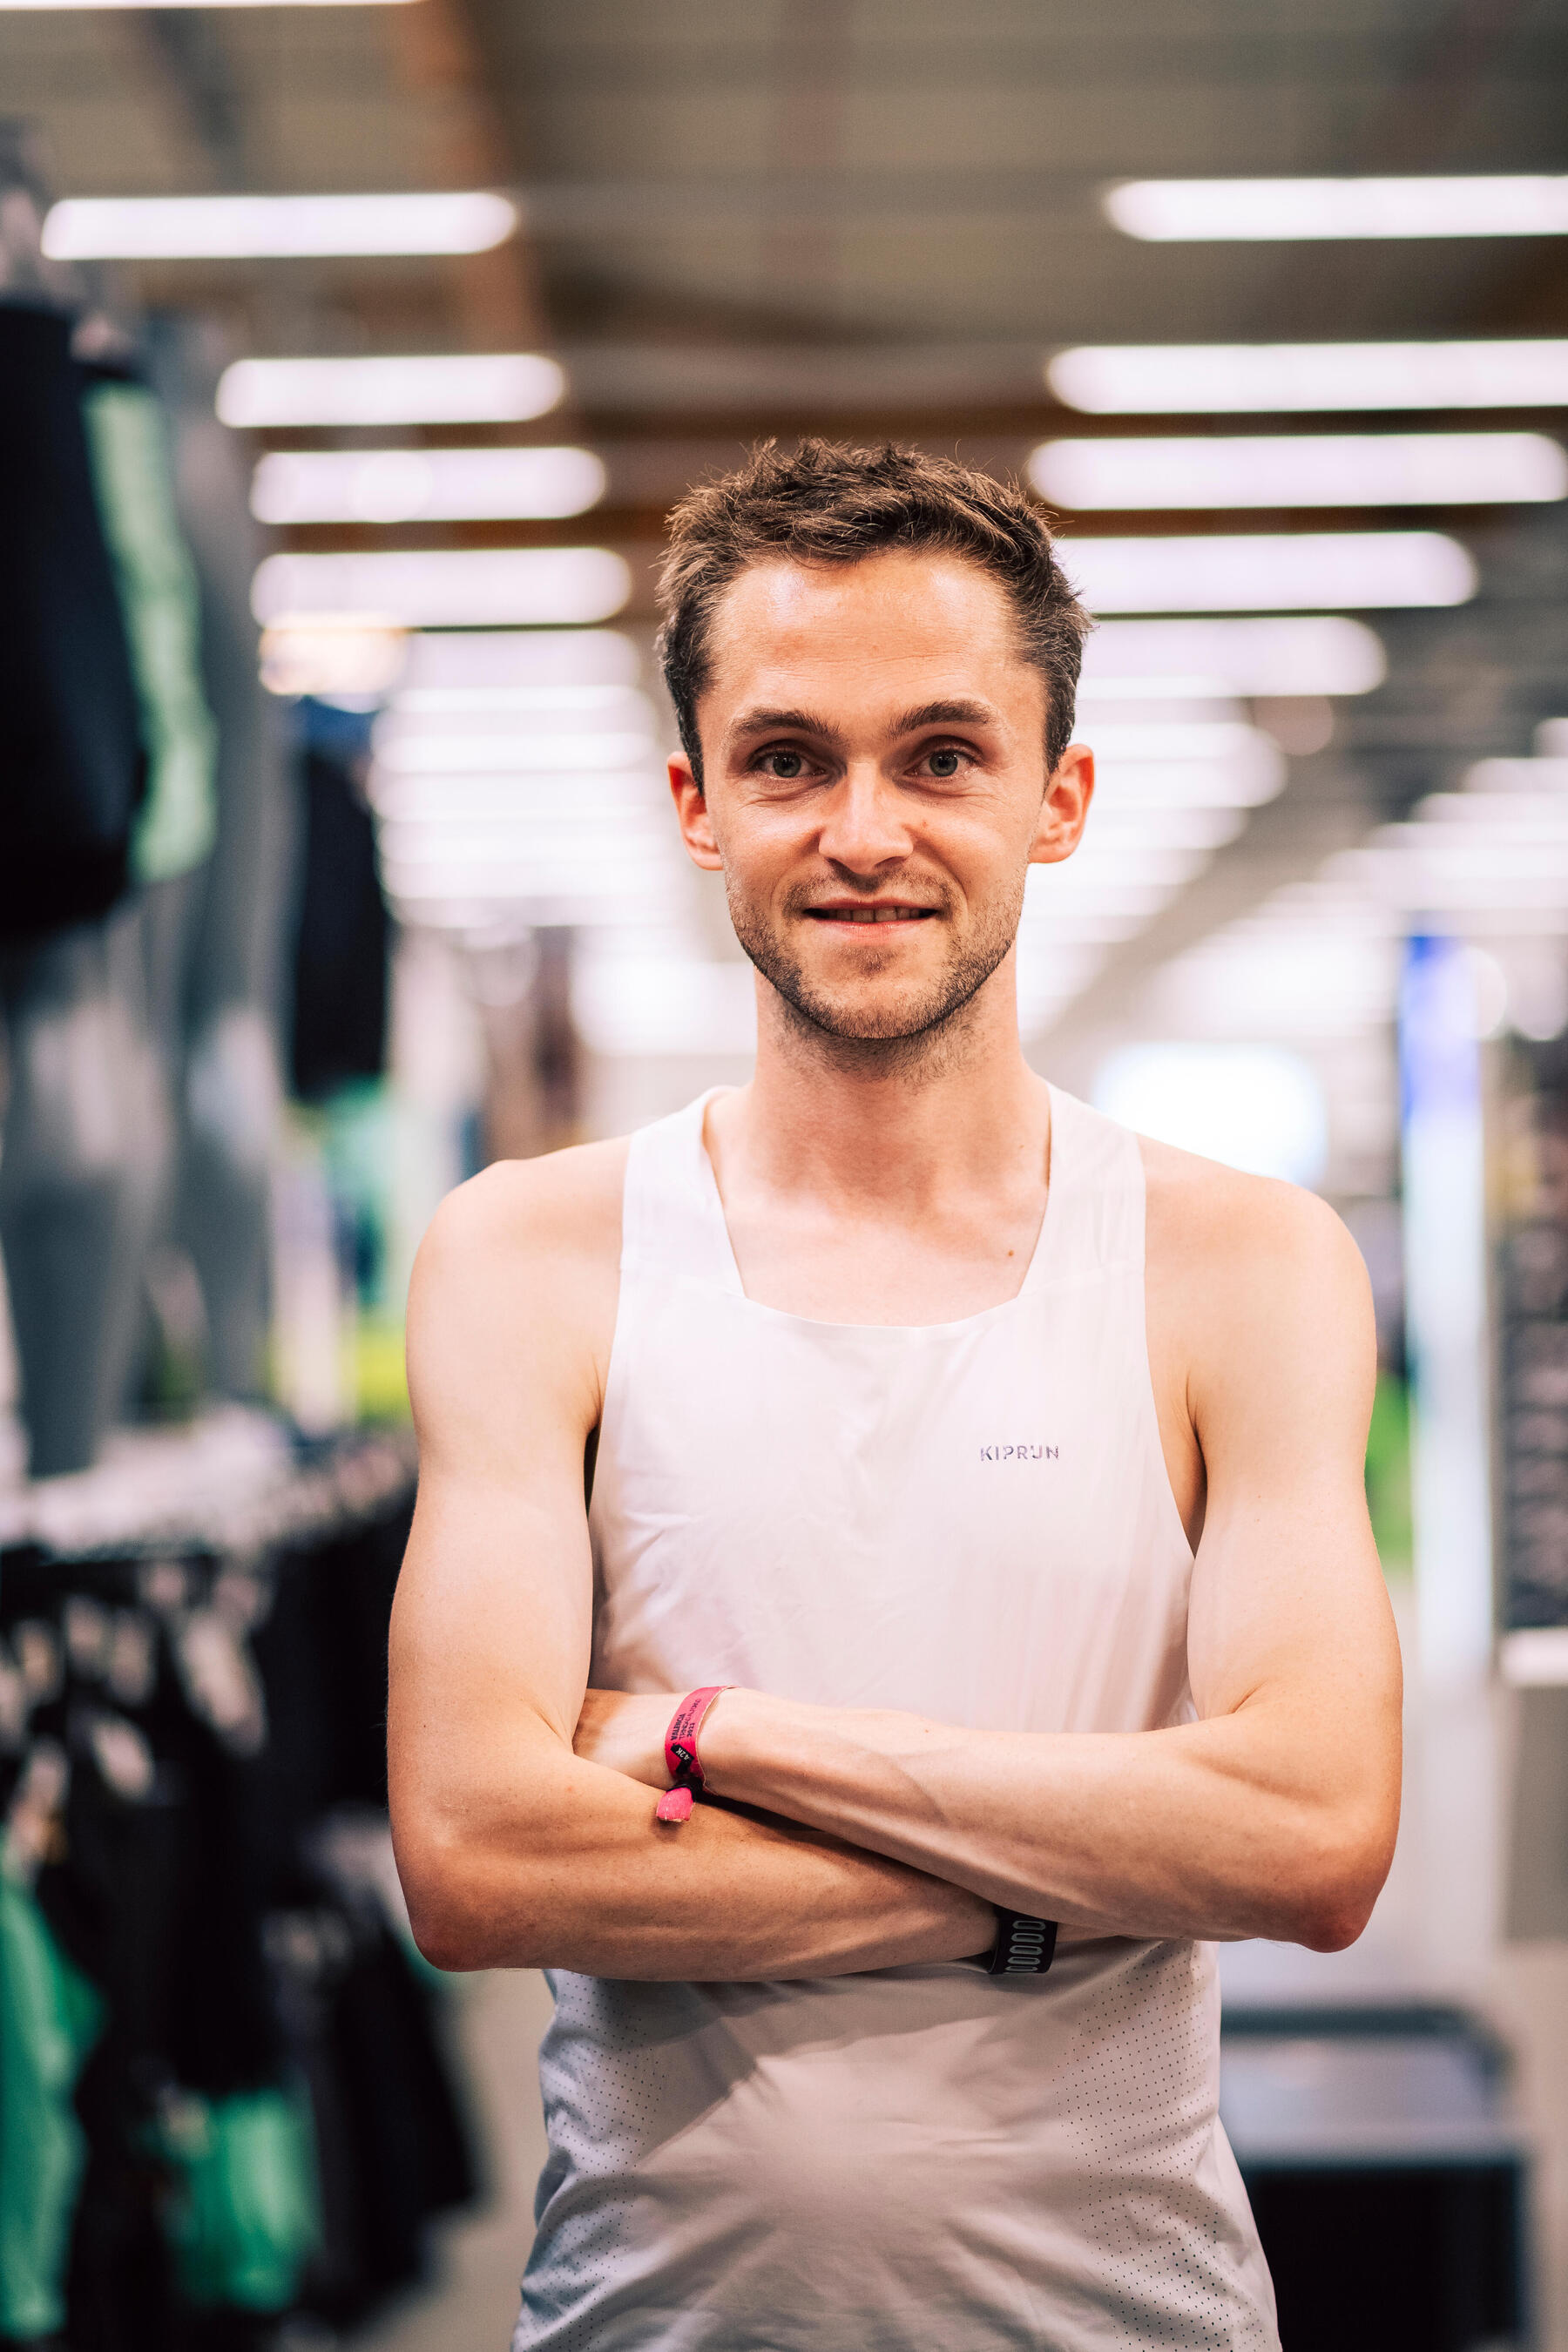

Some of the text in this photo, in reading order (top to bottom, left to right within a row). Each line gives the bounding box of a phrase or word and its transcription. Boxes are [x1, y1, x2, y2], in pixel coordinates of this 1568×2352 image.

[980, 1444, 1059, 1462] KIPRUN
[671, 1713, 686, 1740] VALENCIA
[676, 1747, 690, 1760] 42K
